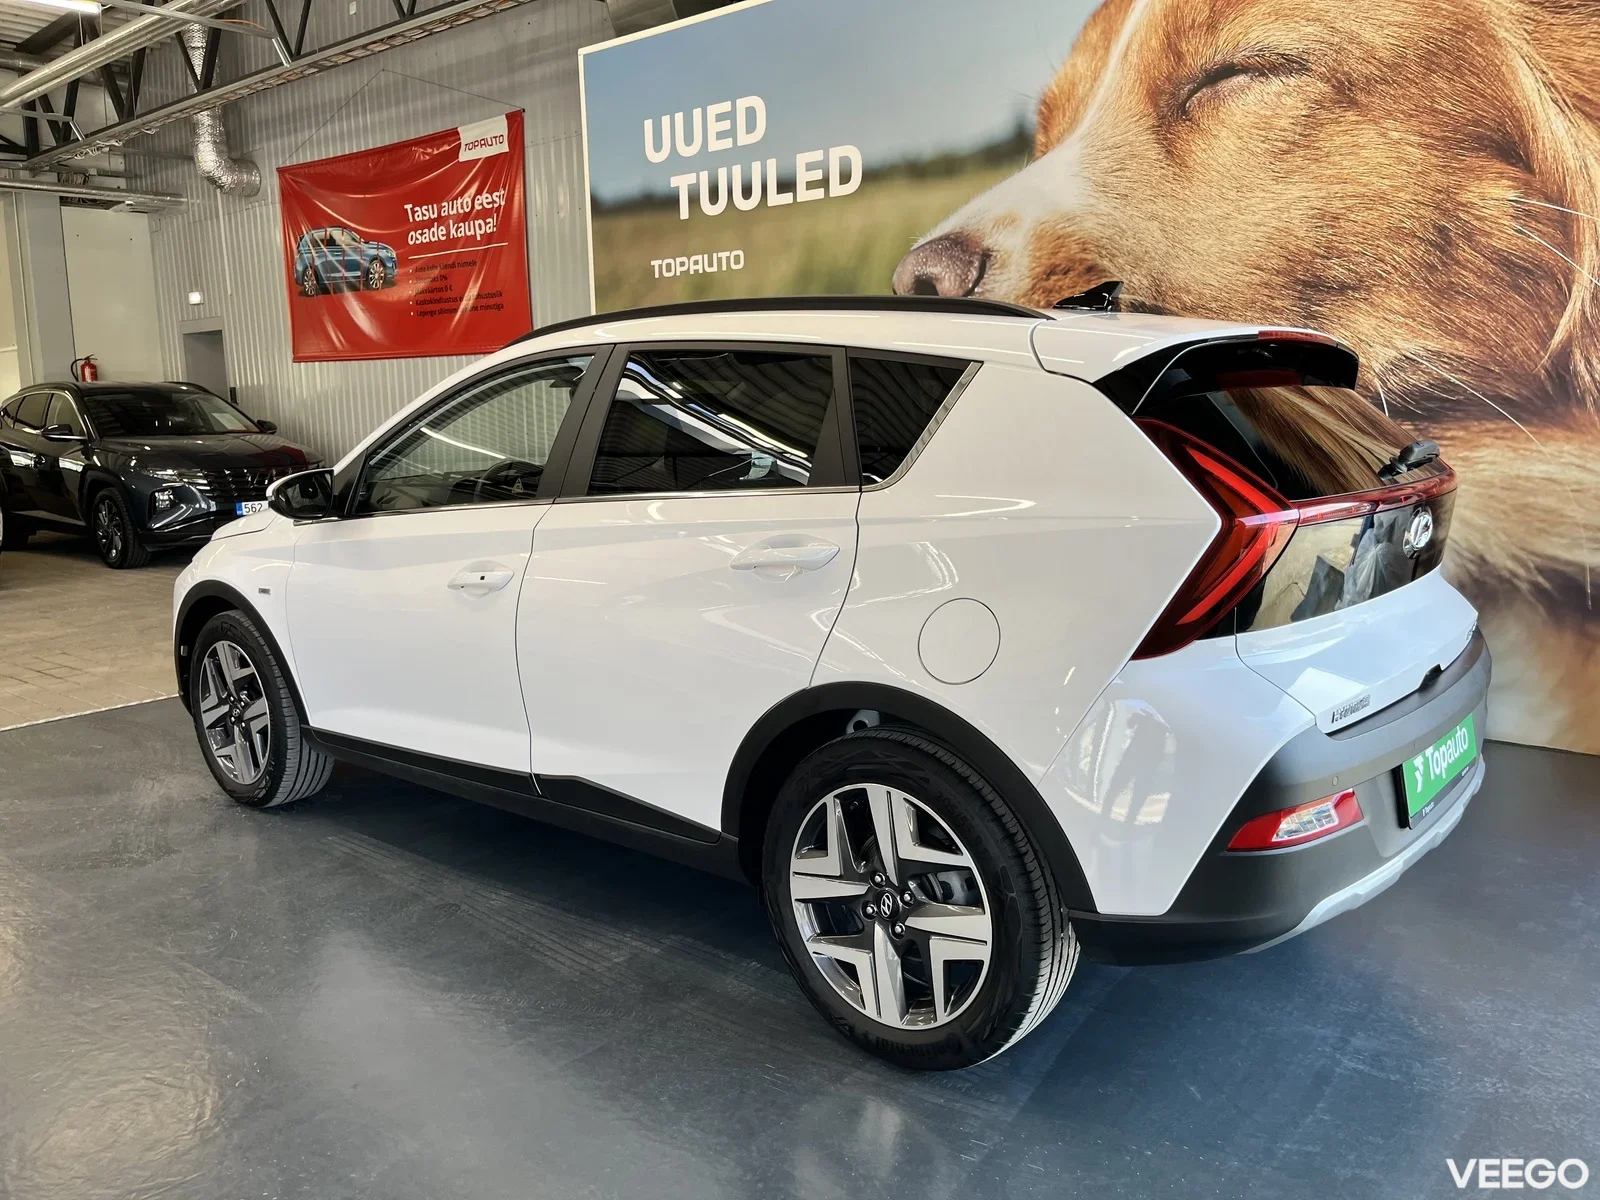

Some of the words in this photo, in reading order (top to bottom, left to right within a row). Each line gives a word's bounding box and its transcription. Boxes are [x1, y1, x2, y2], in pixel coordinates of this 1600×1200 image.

[464, 134, 504, 152] TOPAUTO
[644, 95, 767, 164] UUED
[670, 144, 863, 220] TUULED
[404, 203, 438, 222] Tasu
[441, 196, 472, 217] auto
[474, 188, 505, 210] eest
[408, 222, 447, 245] osade
[449, 213, 497, 240] kaupa!
[651, 249, 745, 278] TOPAUTO
[244, 502, 263, 514] 562
[1425, 725, 1469, 781] Topauto
